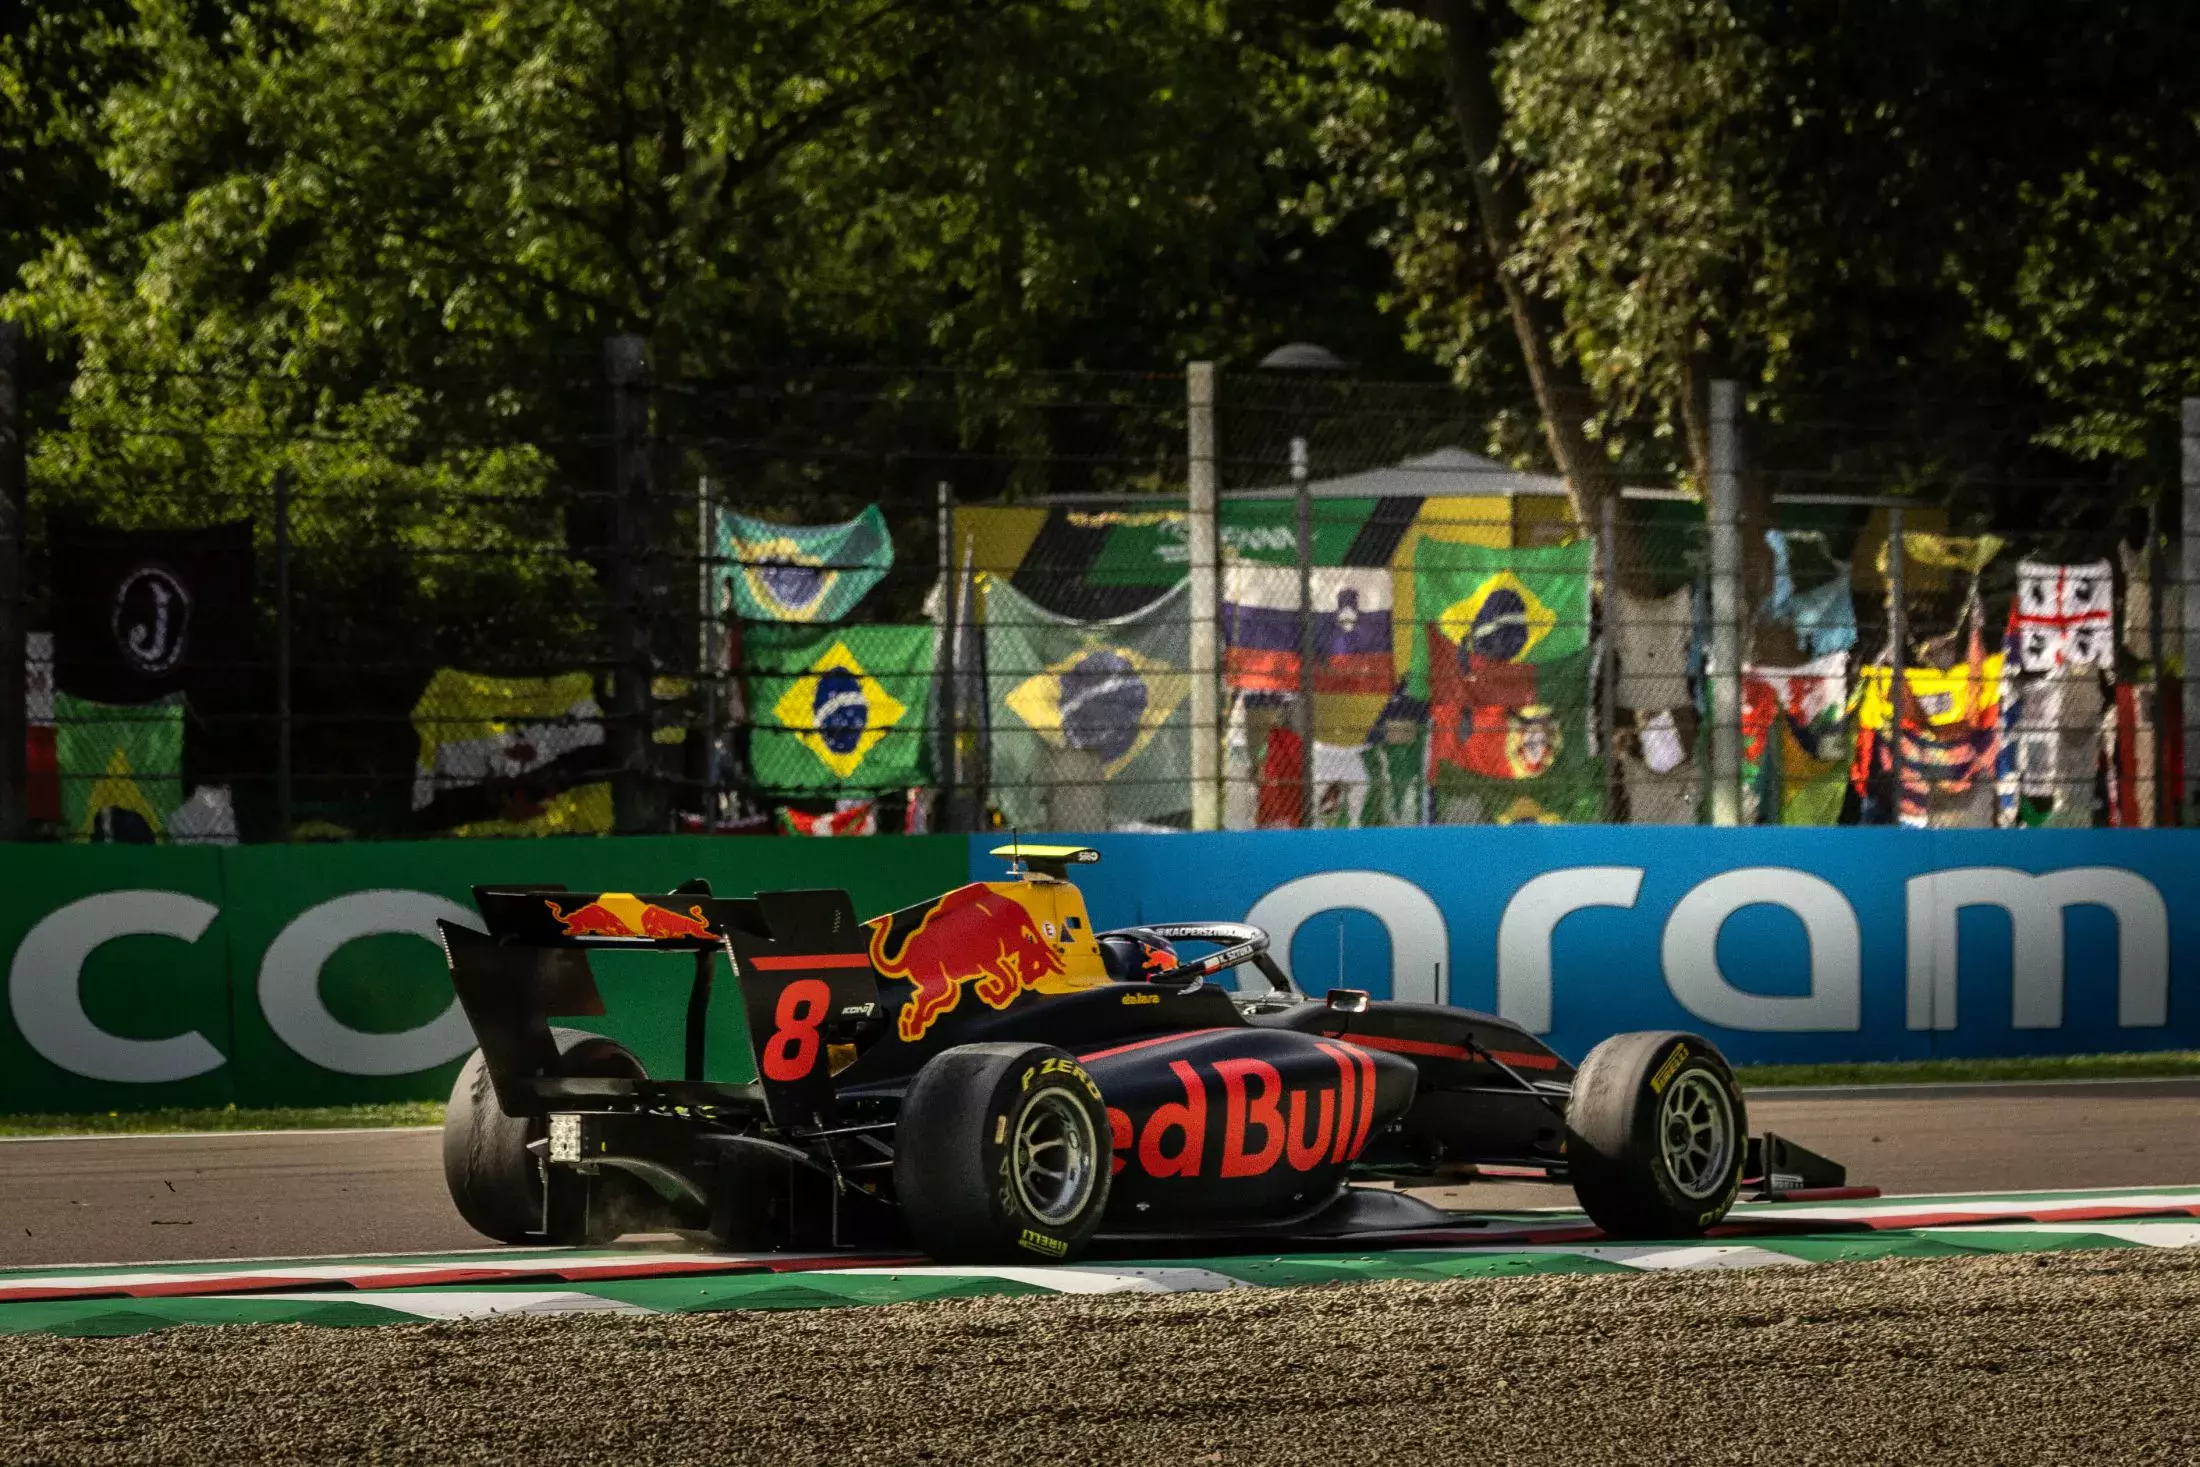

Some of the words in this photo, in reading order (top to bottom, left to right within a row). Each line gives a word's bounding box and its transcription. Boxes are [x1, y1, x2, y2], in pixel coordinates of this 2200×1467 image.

[763, 979, 831, 1081] 8
[1021, 1066, 1036, 1092] P
[1040, 1057, 1101, 1101] ZERO
[1105, 1060, 1208, 1178] ed
[1212, 1043, 1376, 1179] Bull
